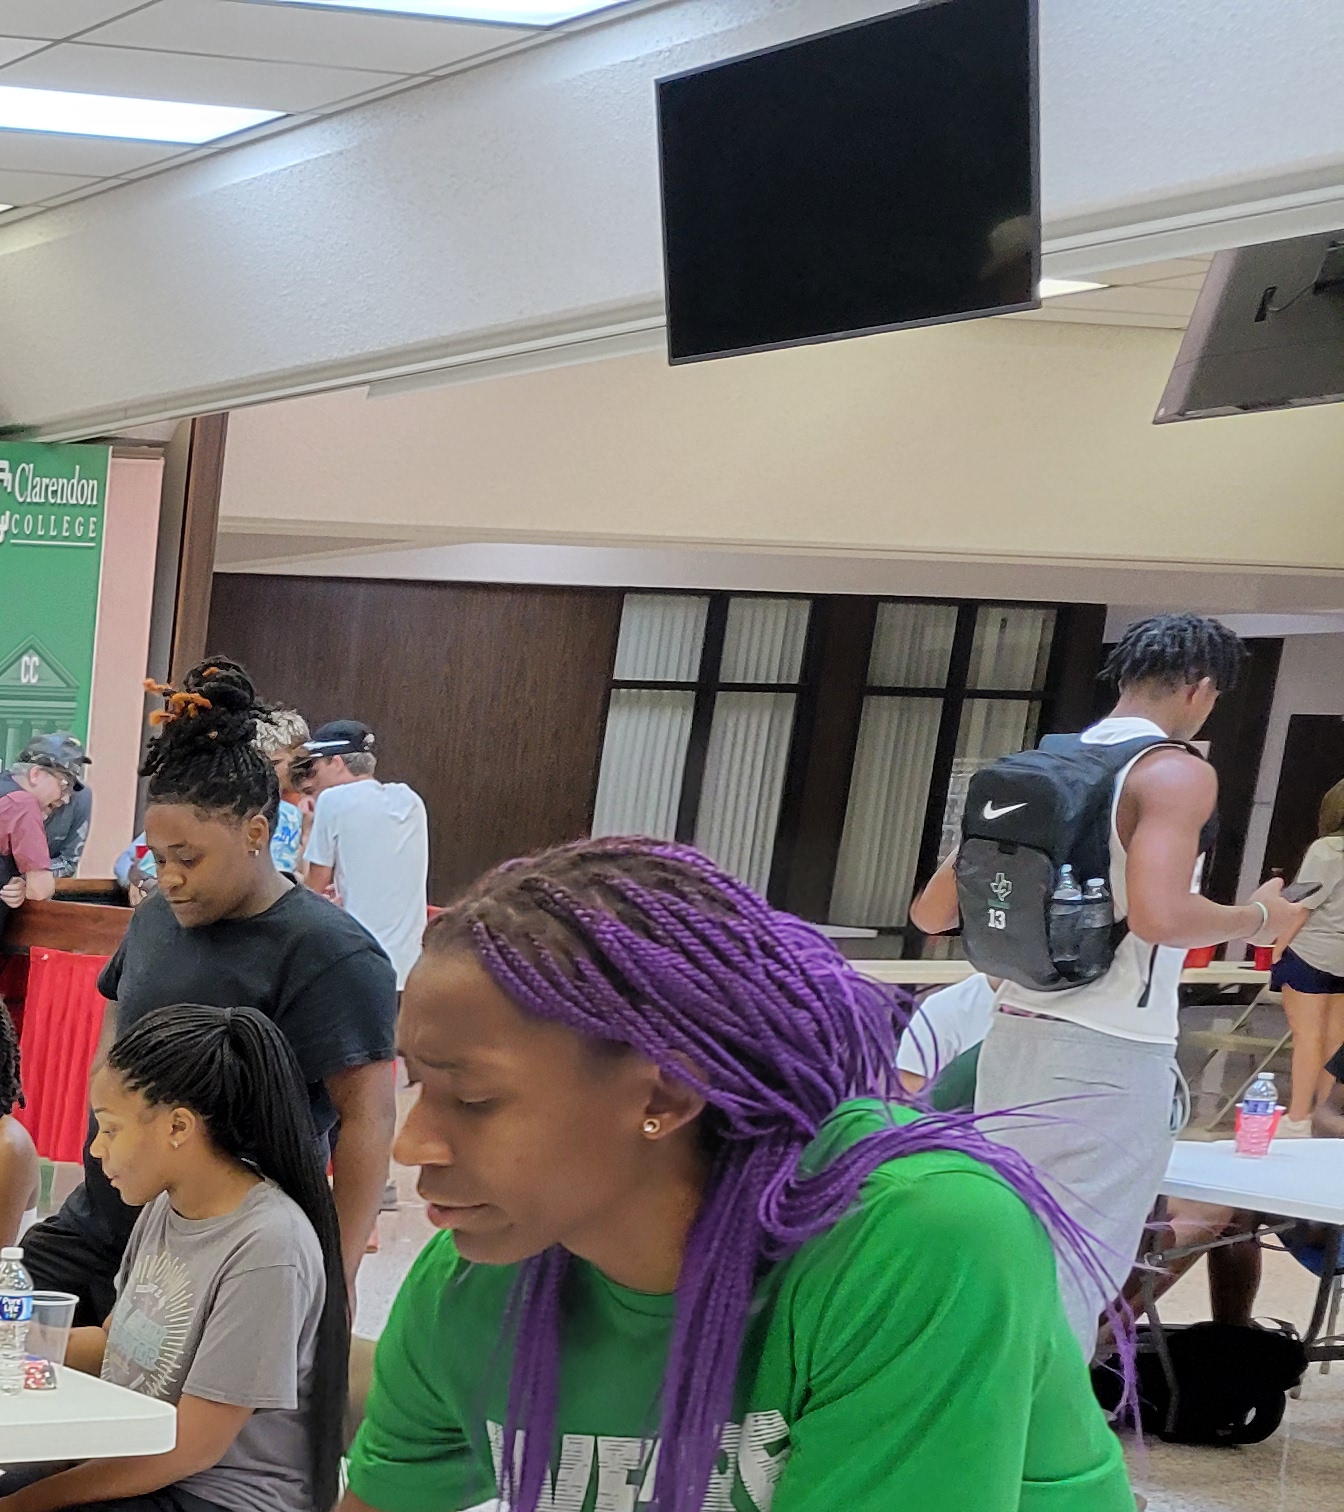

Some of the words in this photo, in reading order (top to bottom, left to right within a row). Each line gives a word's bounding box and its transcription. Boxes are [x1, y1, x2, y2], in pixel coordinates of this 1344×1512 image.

[14, 462, 98, 506] Clarendon
[11, 514, 97, 538] COLLEGE
[20, 656, 40, 684] CC
[987, 908, 1006, 930] 13
